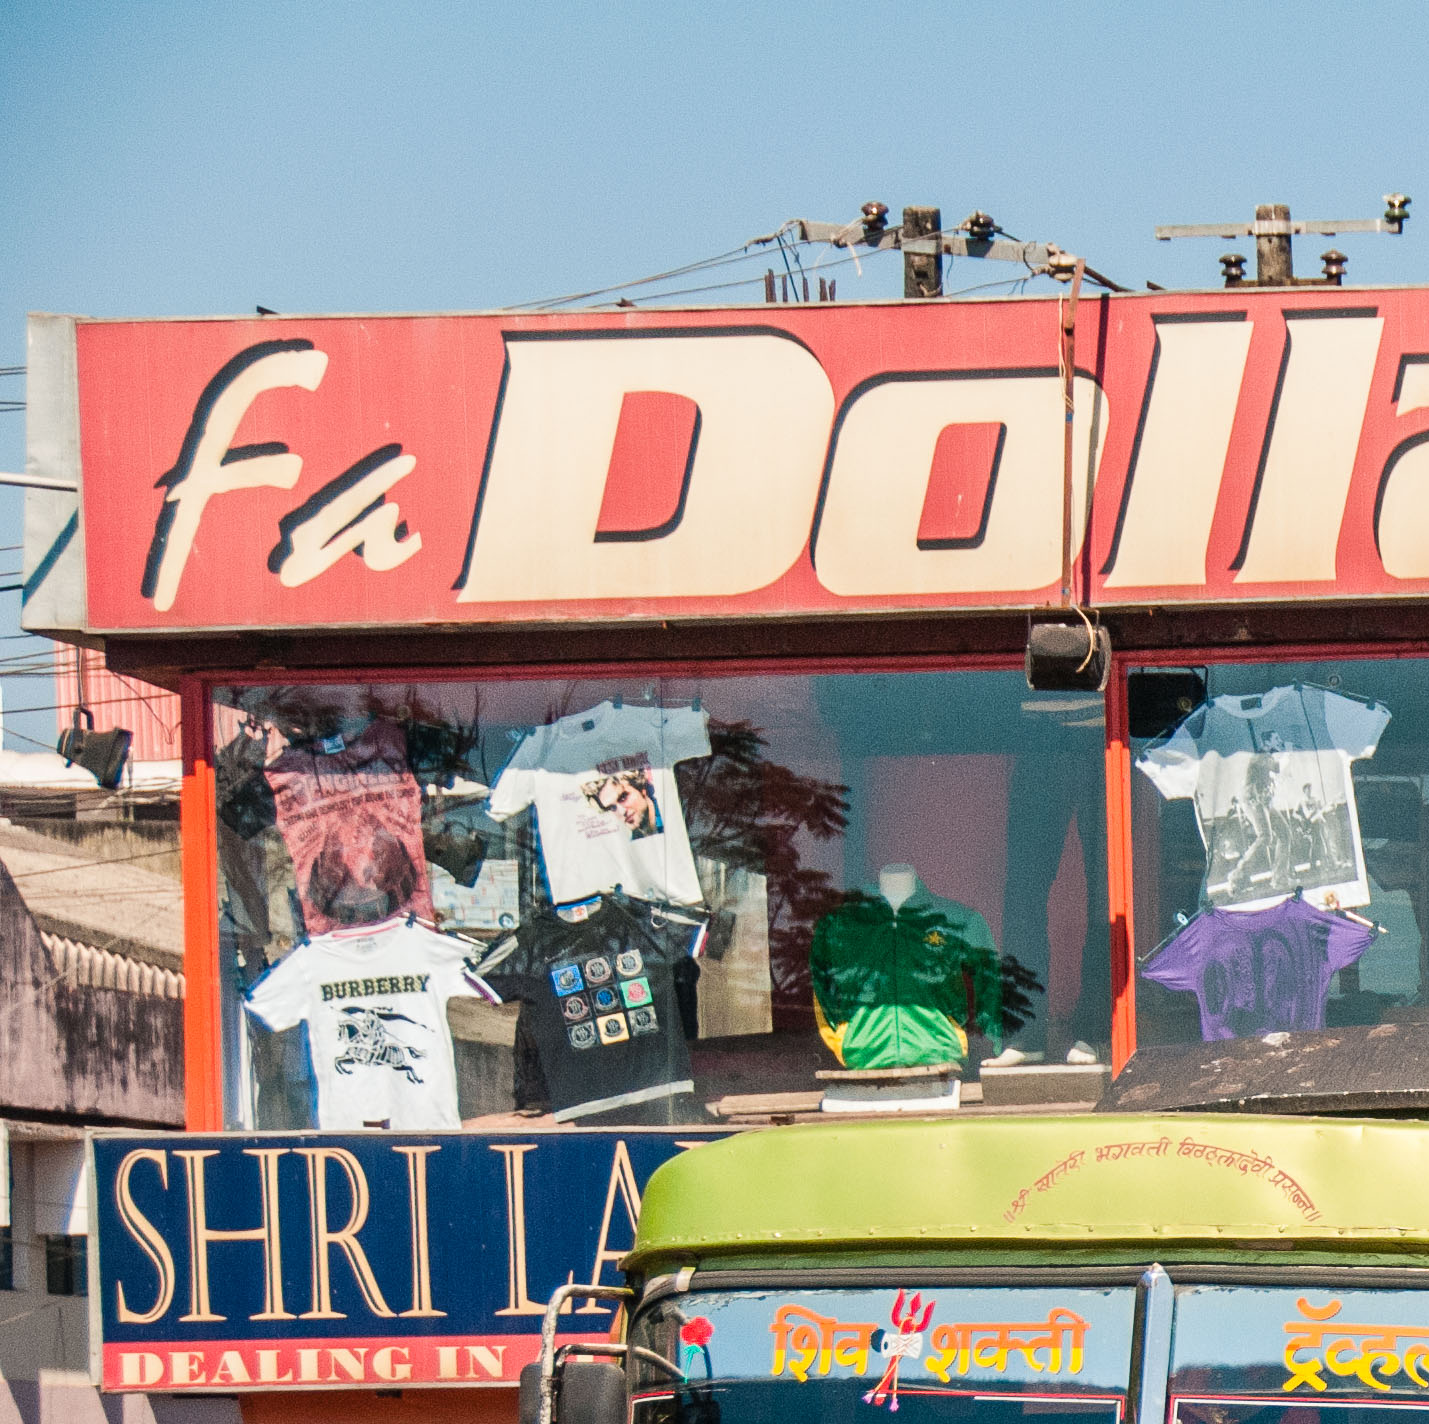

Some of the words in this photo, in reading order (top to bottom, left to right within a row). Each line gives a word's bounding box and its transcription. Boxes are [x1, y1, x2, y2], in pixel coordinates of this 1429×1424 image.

[320, 972, 431, 1002] BURBERRY
[115, 1146, 449, 1324] SHRI
[119, 1344, 415, 1389] DEALING
[435, 1344, 509, 1382] IN
